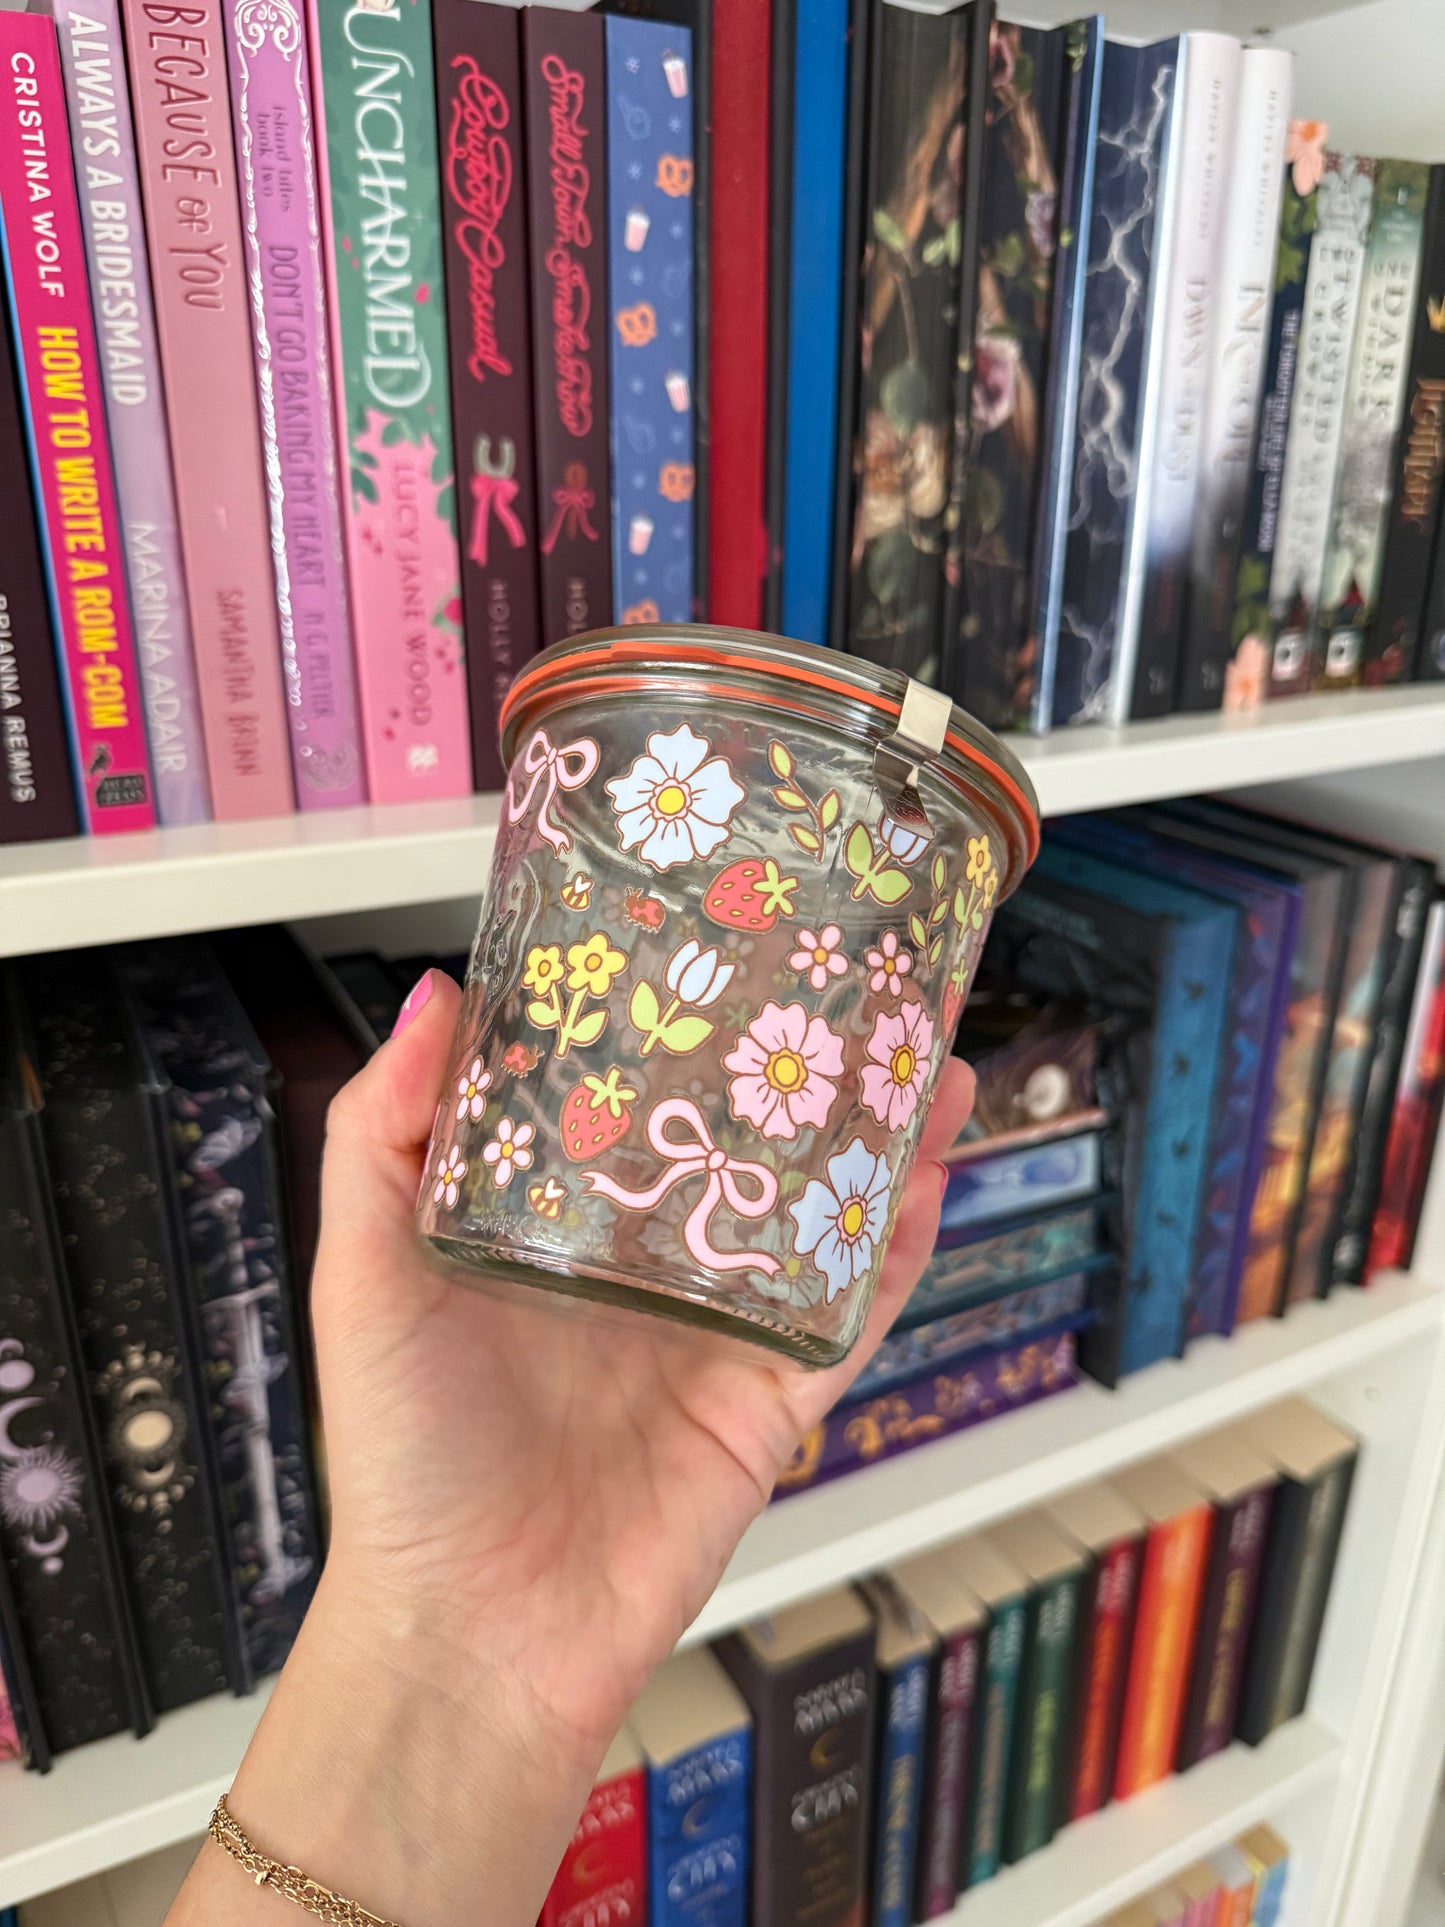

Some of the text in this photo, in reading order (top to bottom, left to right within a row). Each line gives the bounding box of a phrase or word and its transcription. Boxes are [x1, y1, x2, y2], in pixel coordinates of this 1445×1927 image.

[142, 2, 221, 188] BECAUSE
[257, 112, 274, 158] book
[540, 55, 588, 164] Small
[11, 52, 64, 298] CRISTINA WOLF
[67, 11, 148, 406] ALWAYS A BRIDESMAID
[344, 8, 432, 407] UNCHARMED
[445, 55, 514, 382] Cowboy Casual
[551, 164, 592, 248] Town
[170, 244, 228, 312] YOU
[37, 327, 86, 402] HOW
[1376, 283, 1408, 420] DARK
[49, 409, 92, 450] TO
[269, 246, 327, 590] DON'T GO BAKING MY HEART
[55, 458, 106, 554] WRITE
[70, 560, 109, 582] A
[393, 462, 433, 727] LUCY JANE WOOD
[74, 589, 128, 729] ROM-COM
[129, 521, 188, 773] MARINA ADAIR
[214, 587, 256, 704] SAMANTHA
[2, 715, 36, 802] REMUS
